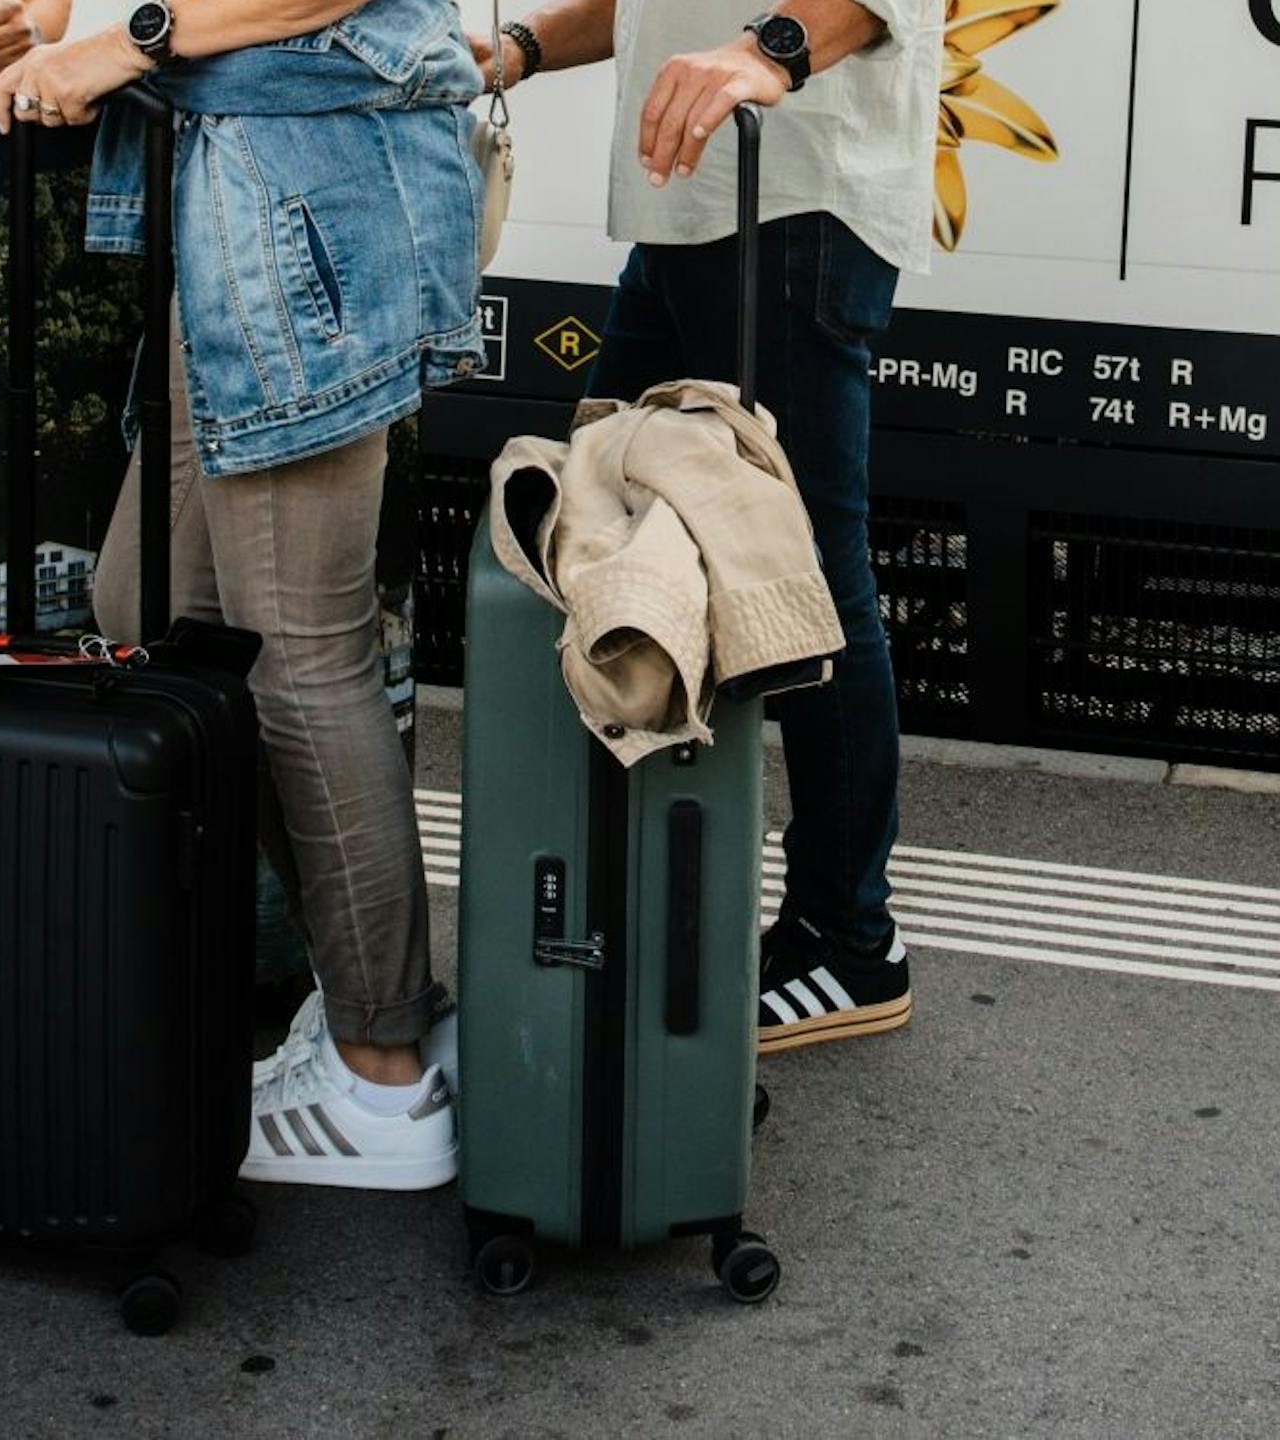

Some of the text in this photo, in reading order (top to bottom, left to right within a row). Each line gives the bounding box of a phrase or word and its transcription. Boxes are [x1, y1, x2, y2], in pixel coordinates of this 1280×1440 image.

[560, 331, 580, 357] R
[1007, 347, 1193, 386] RIC 57t R
[1005, 389, 1268, 441] R 74t R+Mg
